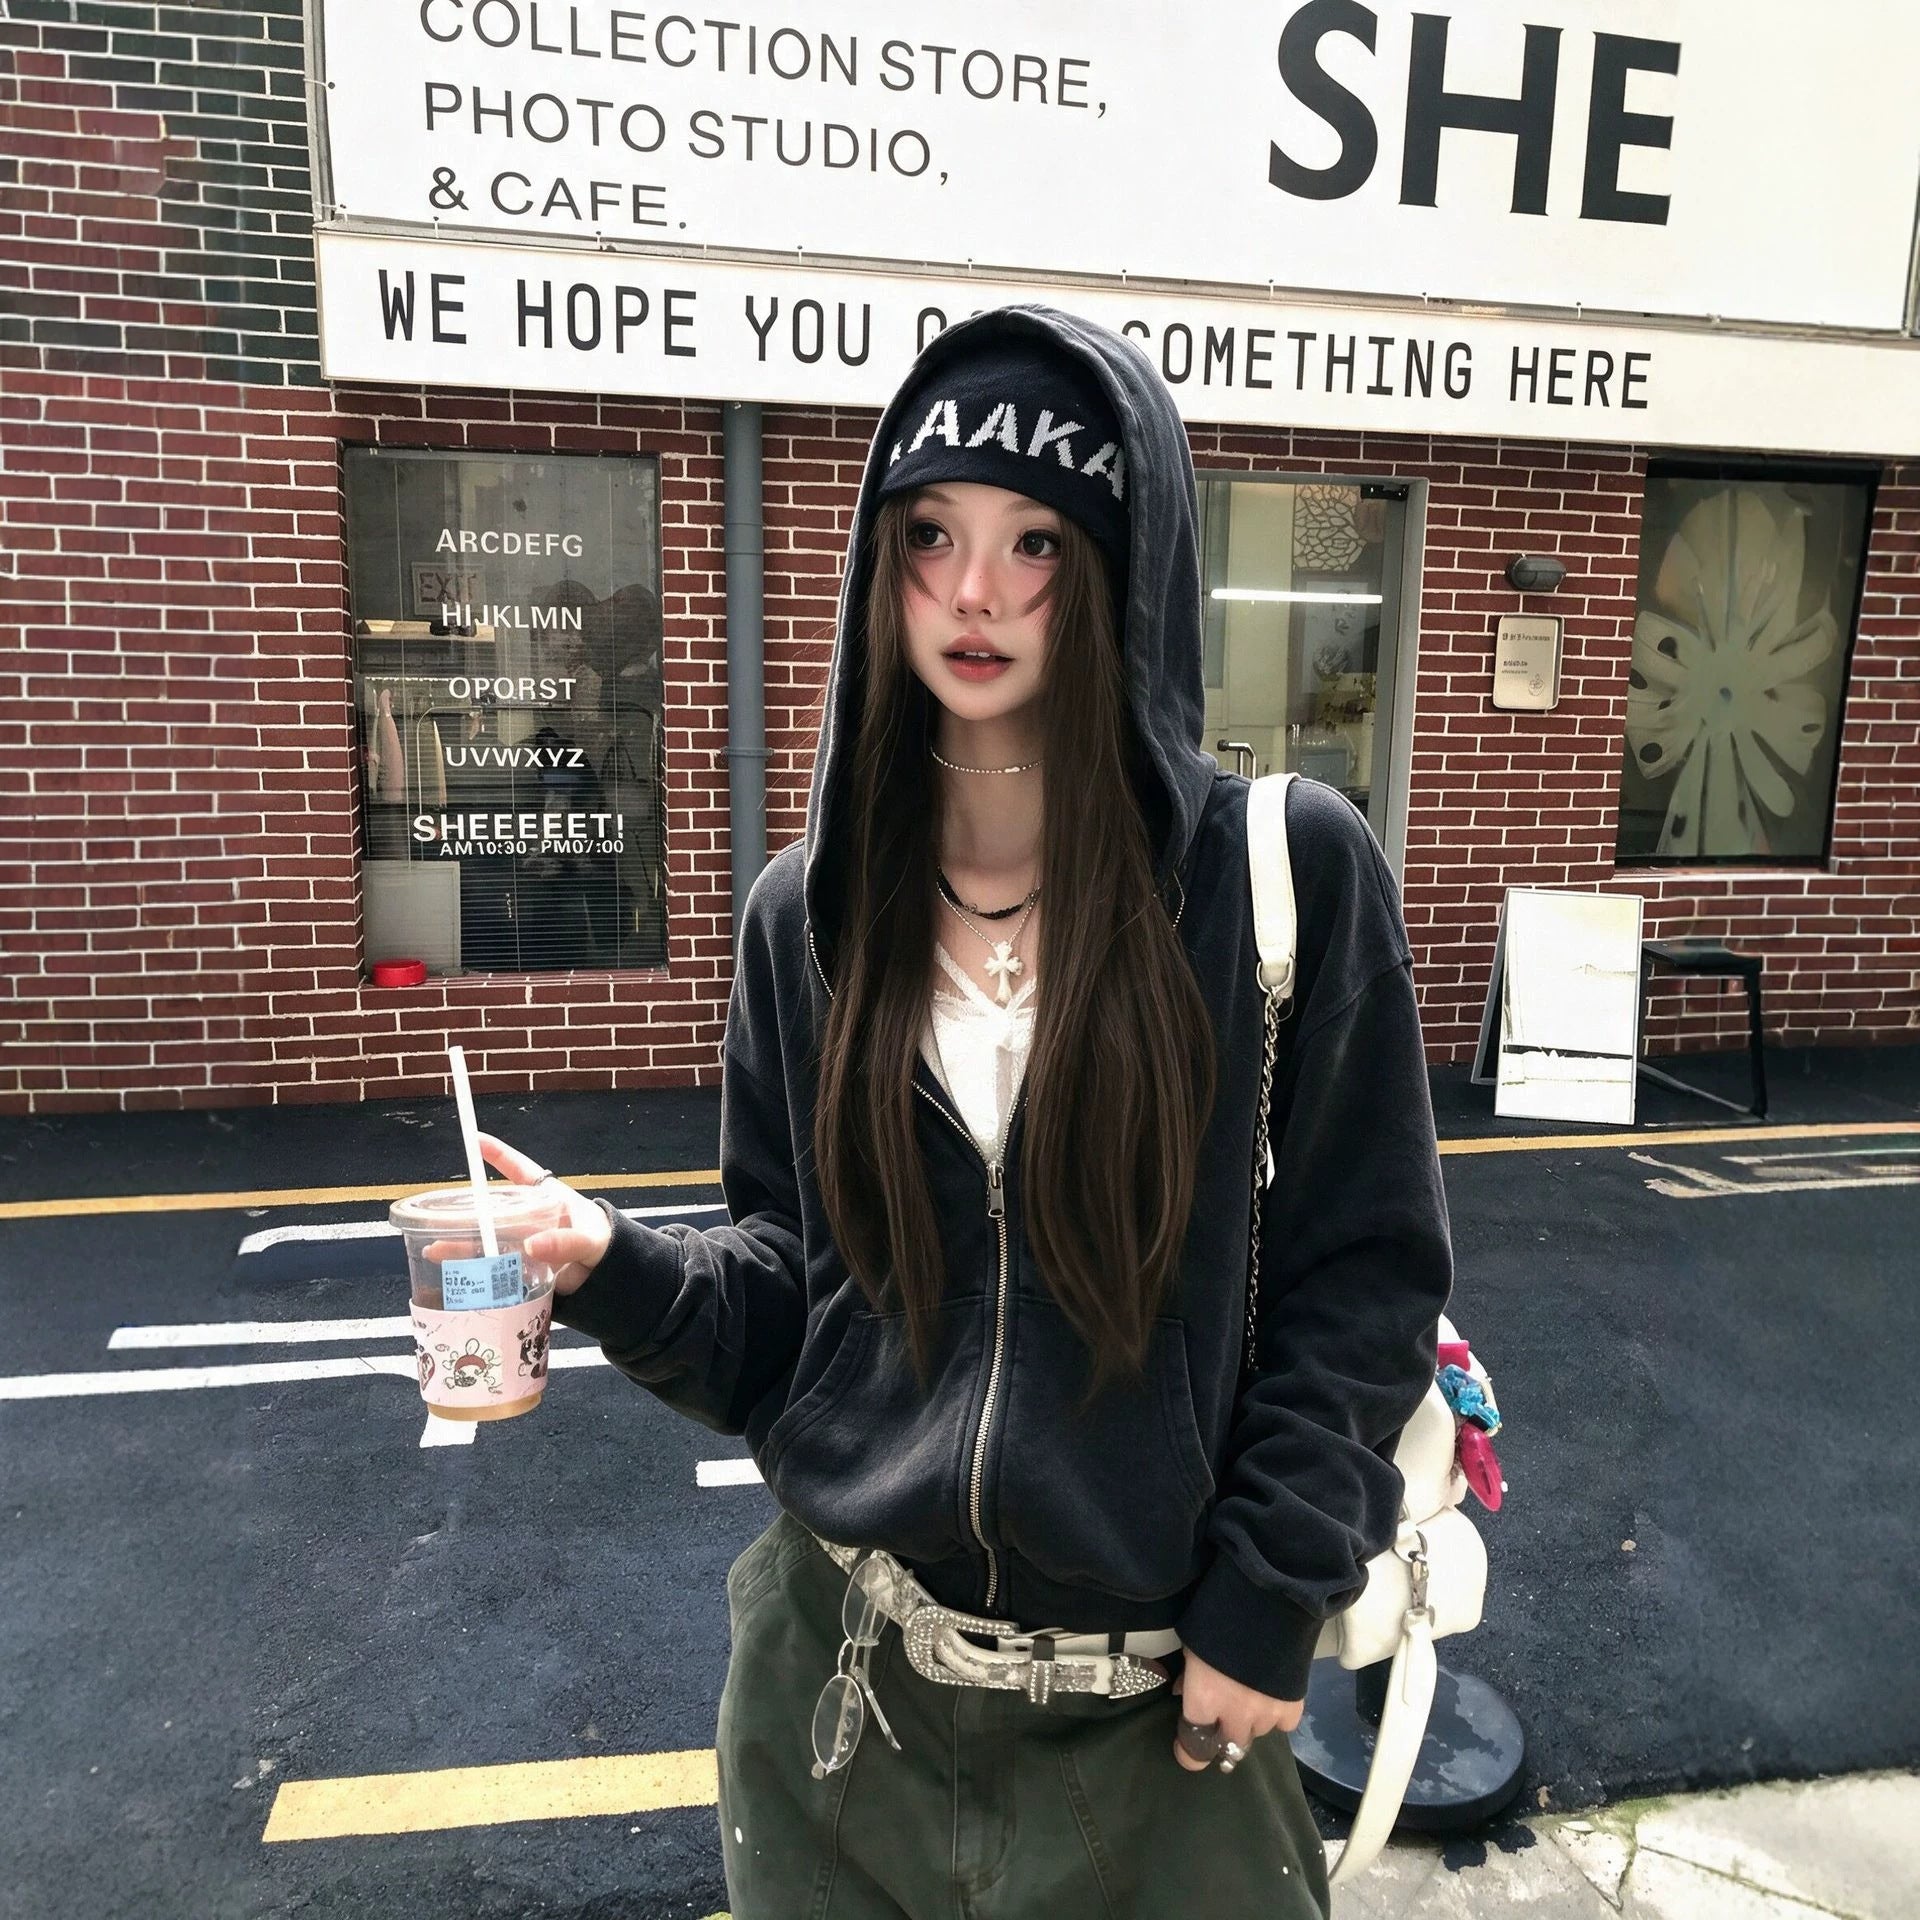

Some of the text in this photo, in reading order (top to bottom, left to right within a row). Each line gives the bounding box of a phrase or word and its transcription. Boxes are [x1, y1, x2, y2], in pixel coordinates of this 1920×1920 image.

[421, 0, 1107, 119] COLLECTION STORE,
[424, 81, 949, 186] PHOTO STUDIO,
[1269, 0, 1682, 226] SHE
[429, 166, 687, 229] & CAFE.
[378, 269, 467, 345] WE
[516, 278, 697, 358] HOPE
[745, 295, 871, 367] YOU
[1121, 320, 1472, 400] OMETHING
[1509, 346, 1652, 409] HERE
[890, 400, 1129, 501] AAKA
[445, 746, 585, 768] UVWXYZ
[413, 813, 624, 842] SHEEEEET!
